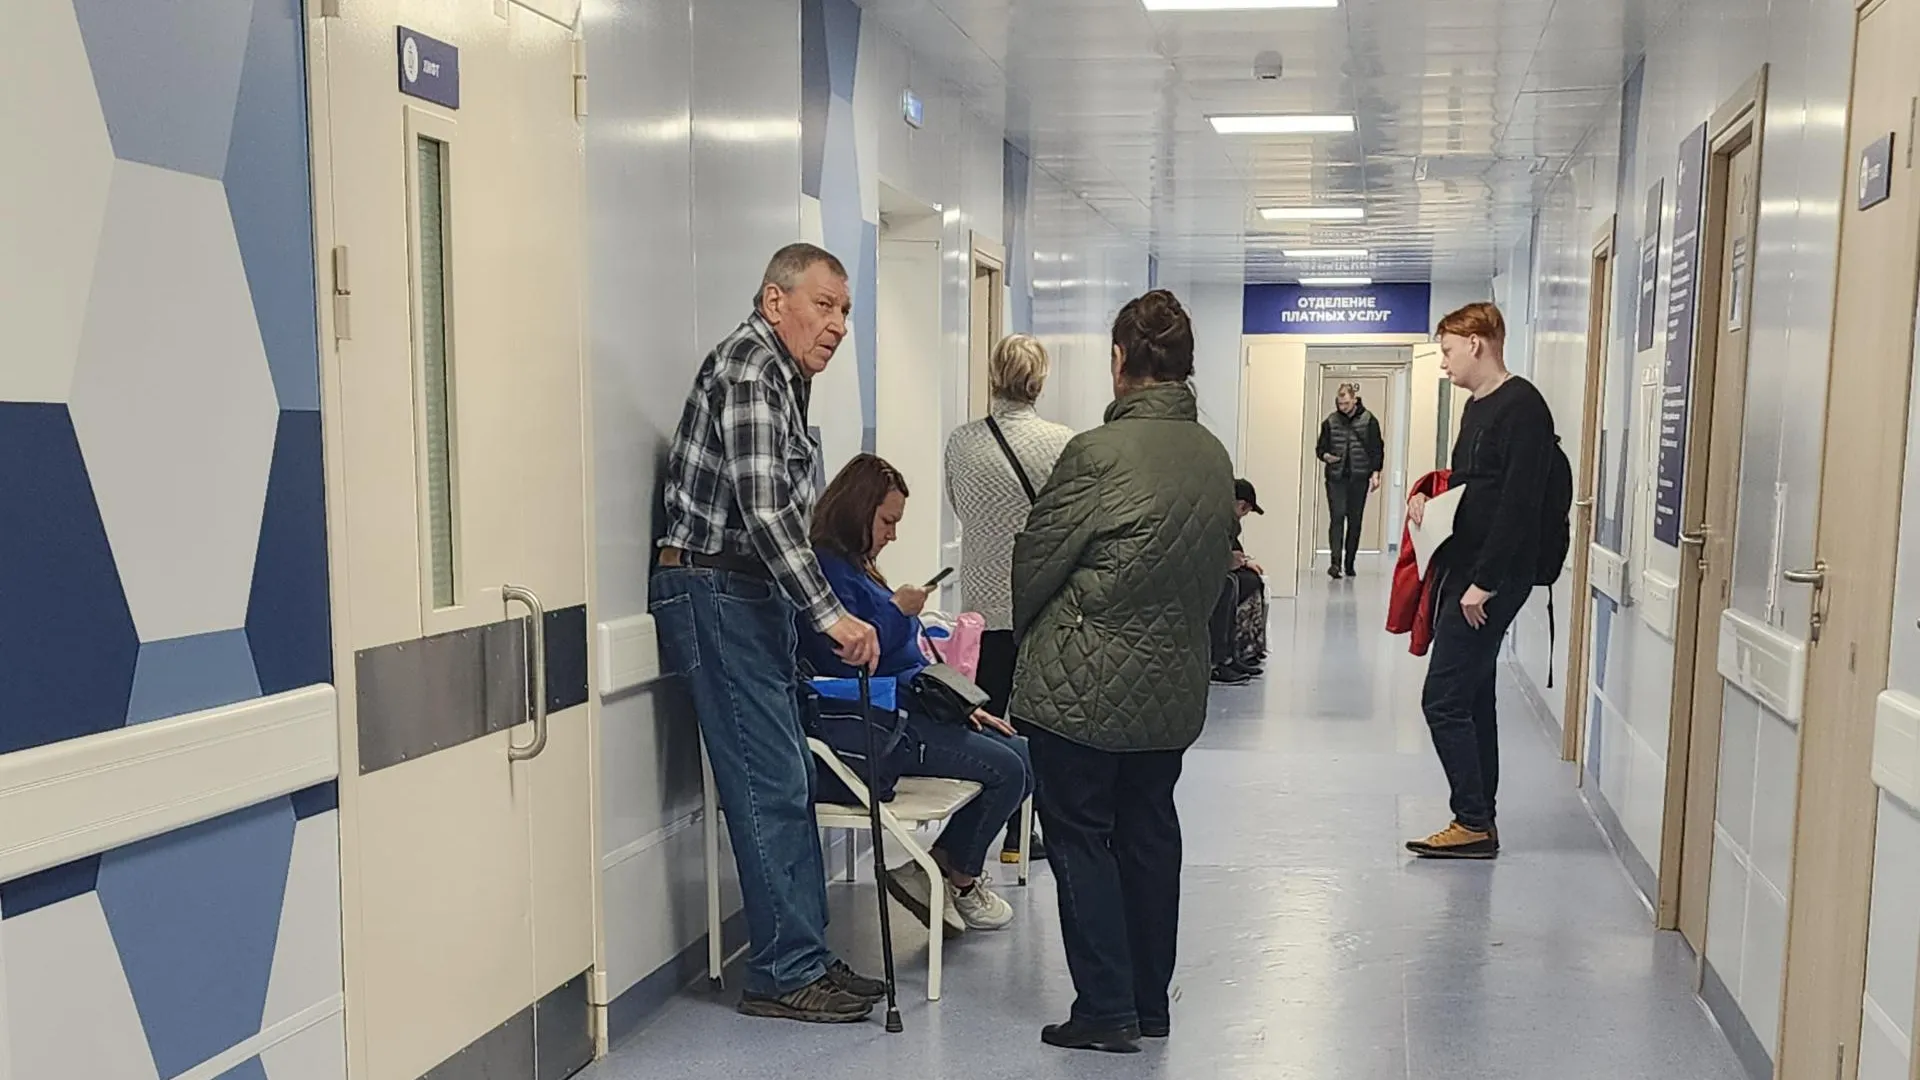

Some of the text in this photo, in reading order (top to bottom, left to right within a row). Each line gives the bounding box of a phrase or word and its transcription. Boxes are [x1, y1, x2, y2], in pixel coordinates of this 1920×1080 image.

[1298, 296, 1376, 309] ОТДЕЛЕНИЕ
[1281, 310, 1391, 322] ПЛАТНЫХ УСЛУГ
